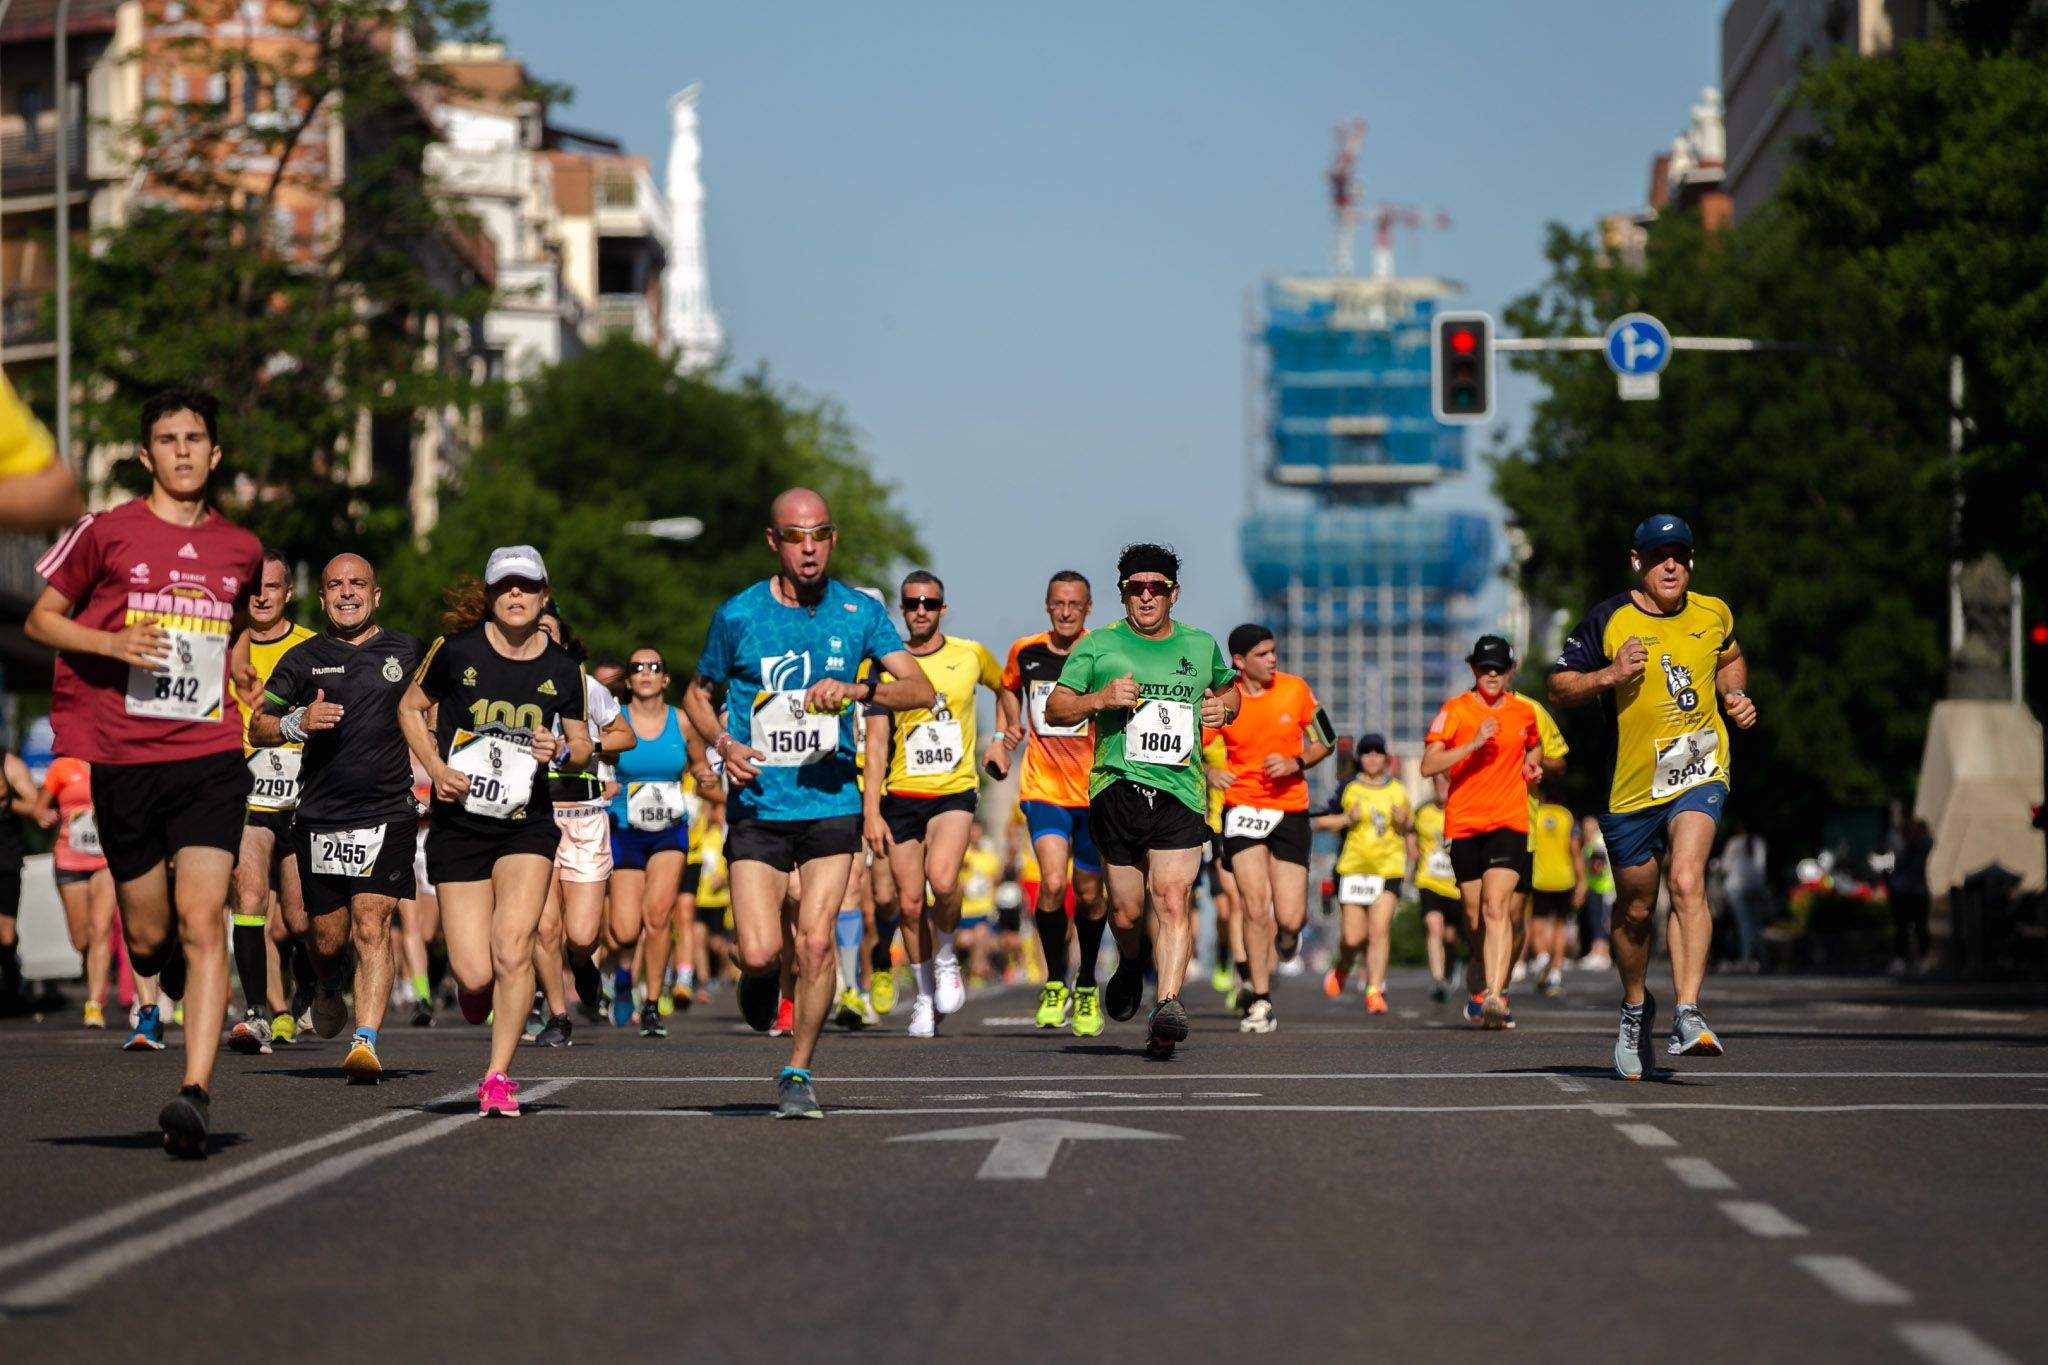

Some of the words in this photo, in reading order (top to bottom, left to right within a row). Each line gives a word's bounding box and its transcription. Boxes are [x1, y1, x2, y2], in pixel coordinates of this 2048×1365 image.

[312, 665, 345, 675] hummel
[155, 676, 199, 703] 842
[1681, 692, 1695, 706] 13
[469, 699, 543, 732] 100
[768, 729, 821, 752] 1504
[1140, 732, 1182, 753] 1804
[915, 748, 953, 765] 3846
[256, 779, 294, 797] 2797
[640, 806, 673, 821] 1584
[1237, 815, 1271, 831] 2237
[323, 841, 366, 865] 2455
